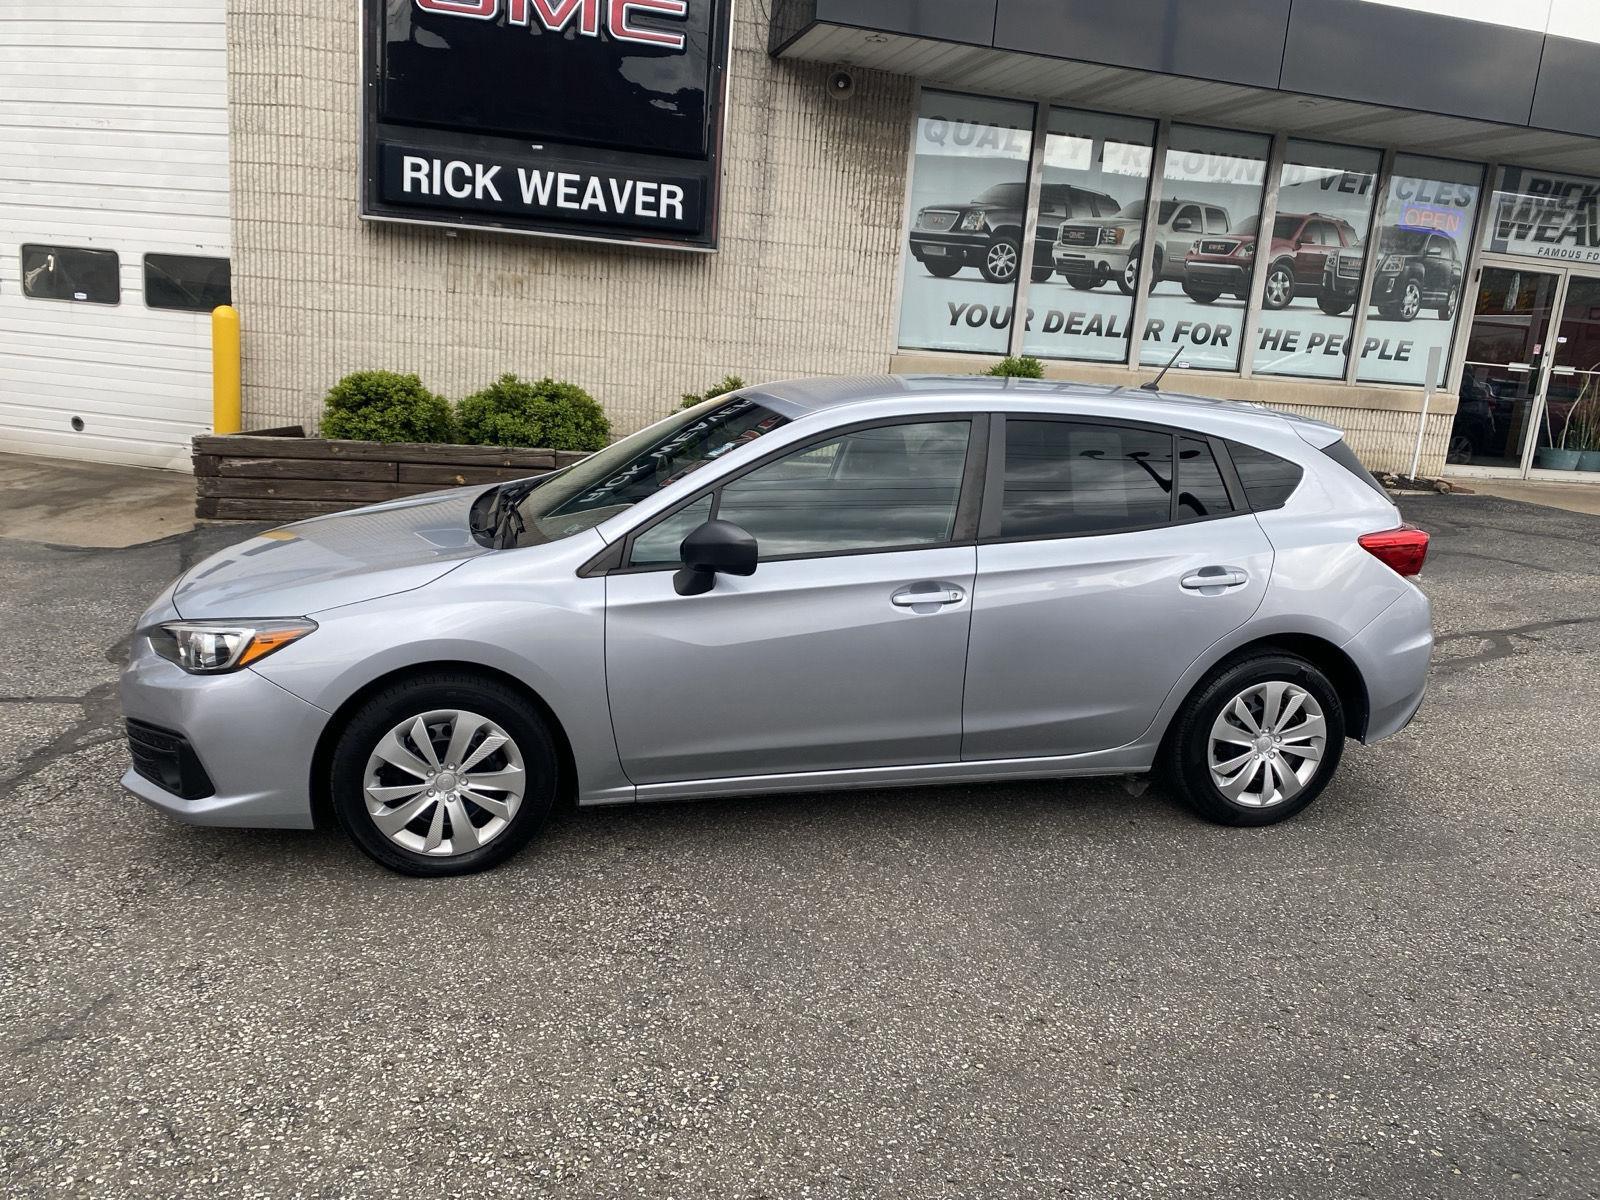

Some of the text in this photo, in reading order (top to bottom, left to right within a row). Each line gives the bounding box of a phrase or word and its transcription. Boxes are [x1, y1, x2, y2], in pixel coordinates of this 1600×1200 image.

[924, 115, 1092, 160] QUALTY
[402, 156, 683, 220] RICK WEAVER
[1406, 208, 1459, 232] OPEN
[1537, 246, 1582, 260] FAMOUS
[1172, 320, 1232, 347] FOR
[1257, 328, 1300, 353] HE
